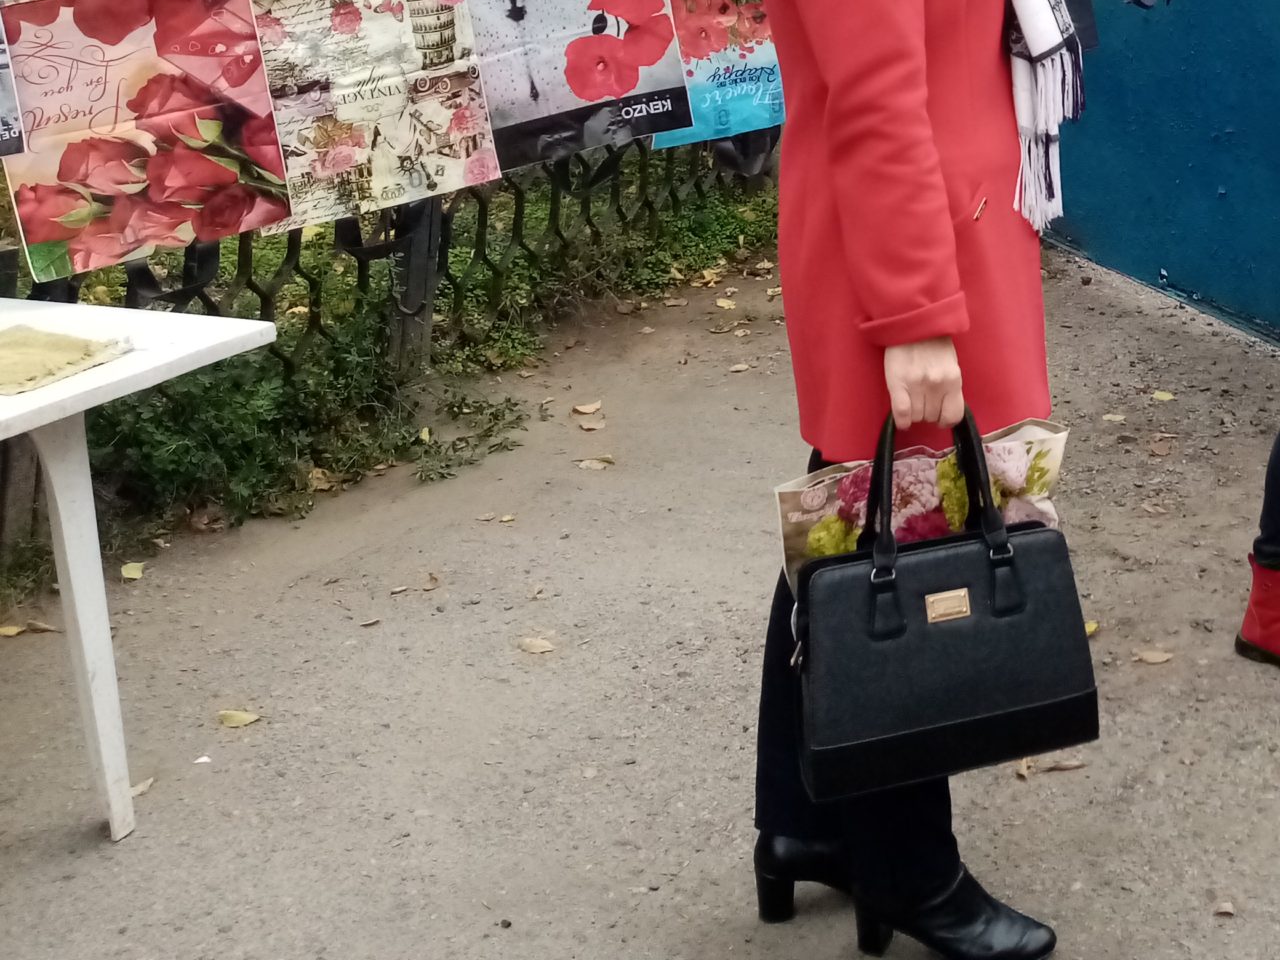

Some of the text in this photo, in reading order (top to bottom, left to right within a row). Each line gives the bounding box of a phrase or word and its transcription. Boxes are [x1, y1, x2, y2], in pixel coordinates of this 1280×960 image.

[40, 59, 79, 98] you
[706, 62, 777, 83] Happy
[337, 84, 402, 105] VINTAGE
[701, 83, 783, 108] Flowers
[21, 77, 128, 154] Present
[621, 98, 672, 119] KENZO
